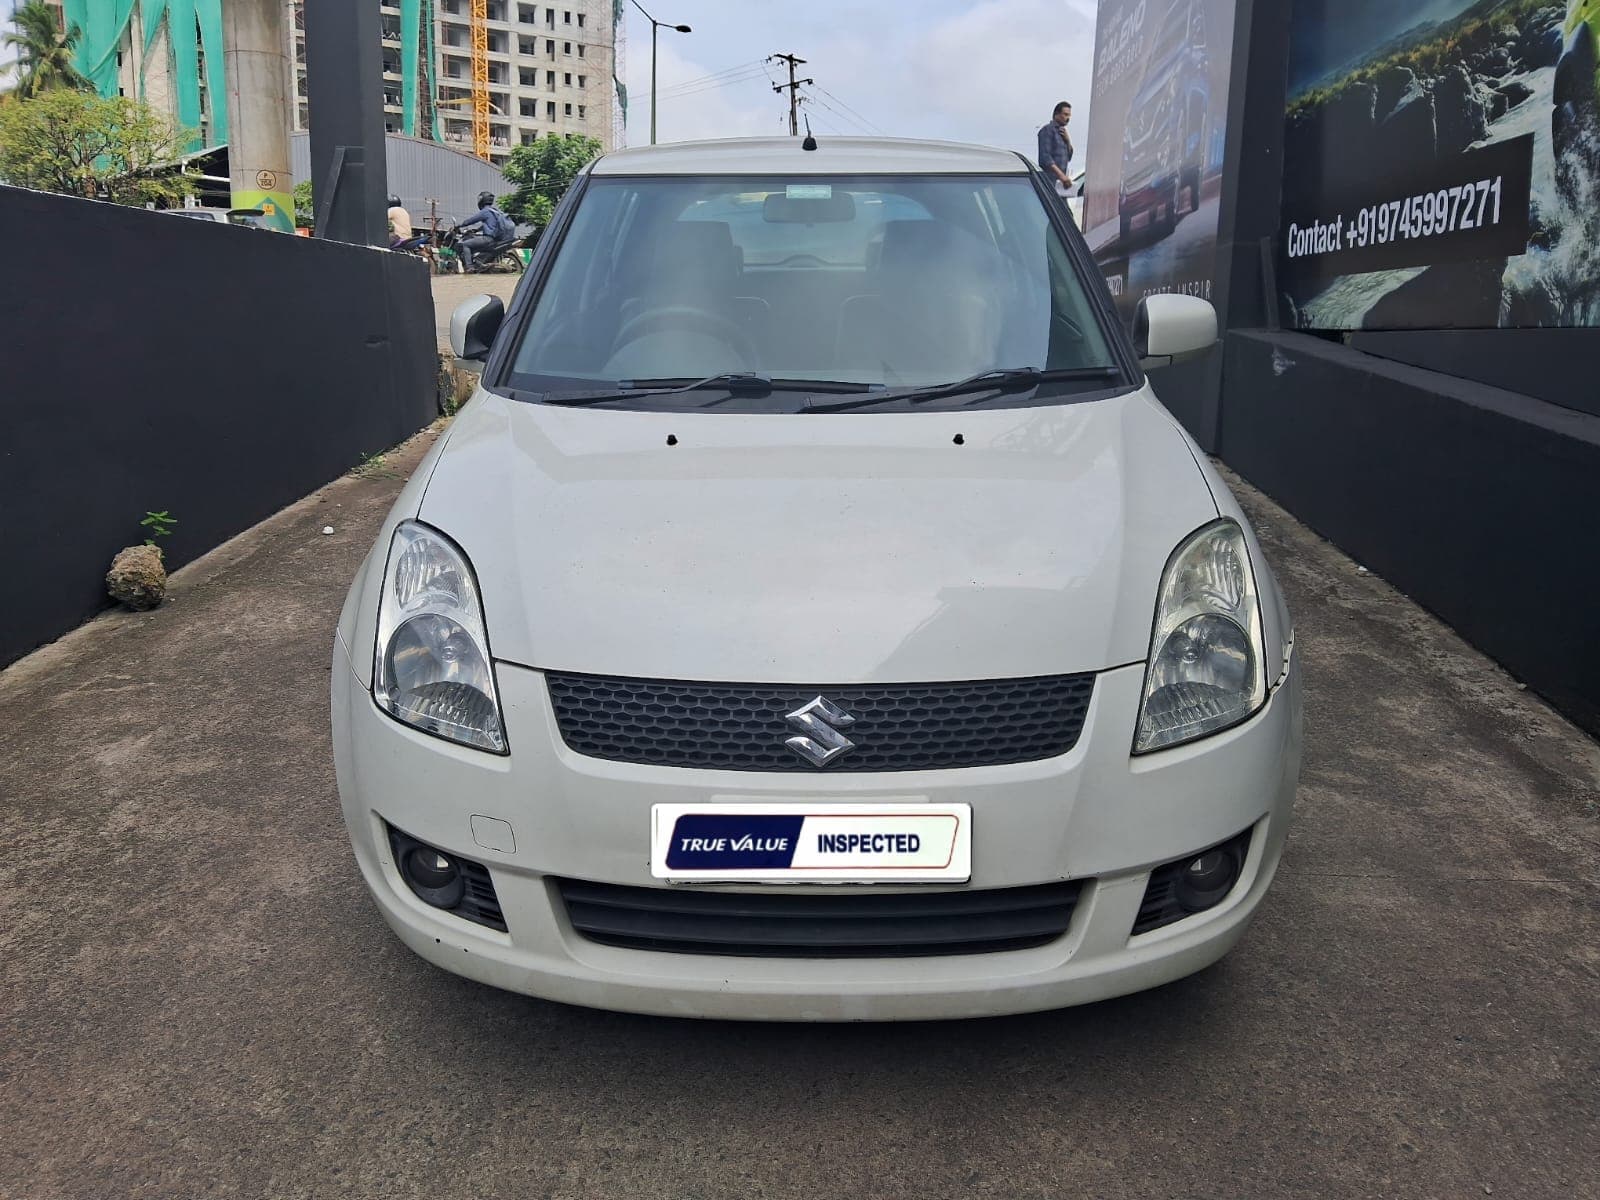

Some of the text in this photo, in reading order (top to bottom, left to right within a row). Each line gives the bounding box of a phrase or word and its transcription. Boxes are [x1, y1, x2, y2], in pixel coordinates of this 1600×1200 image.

[1288, 175, 1503, 258] Contact +919745997271
[680, 833, 921, 854] TRUE VALUE INSPECTED
